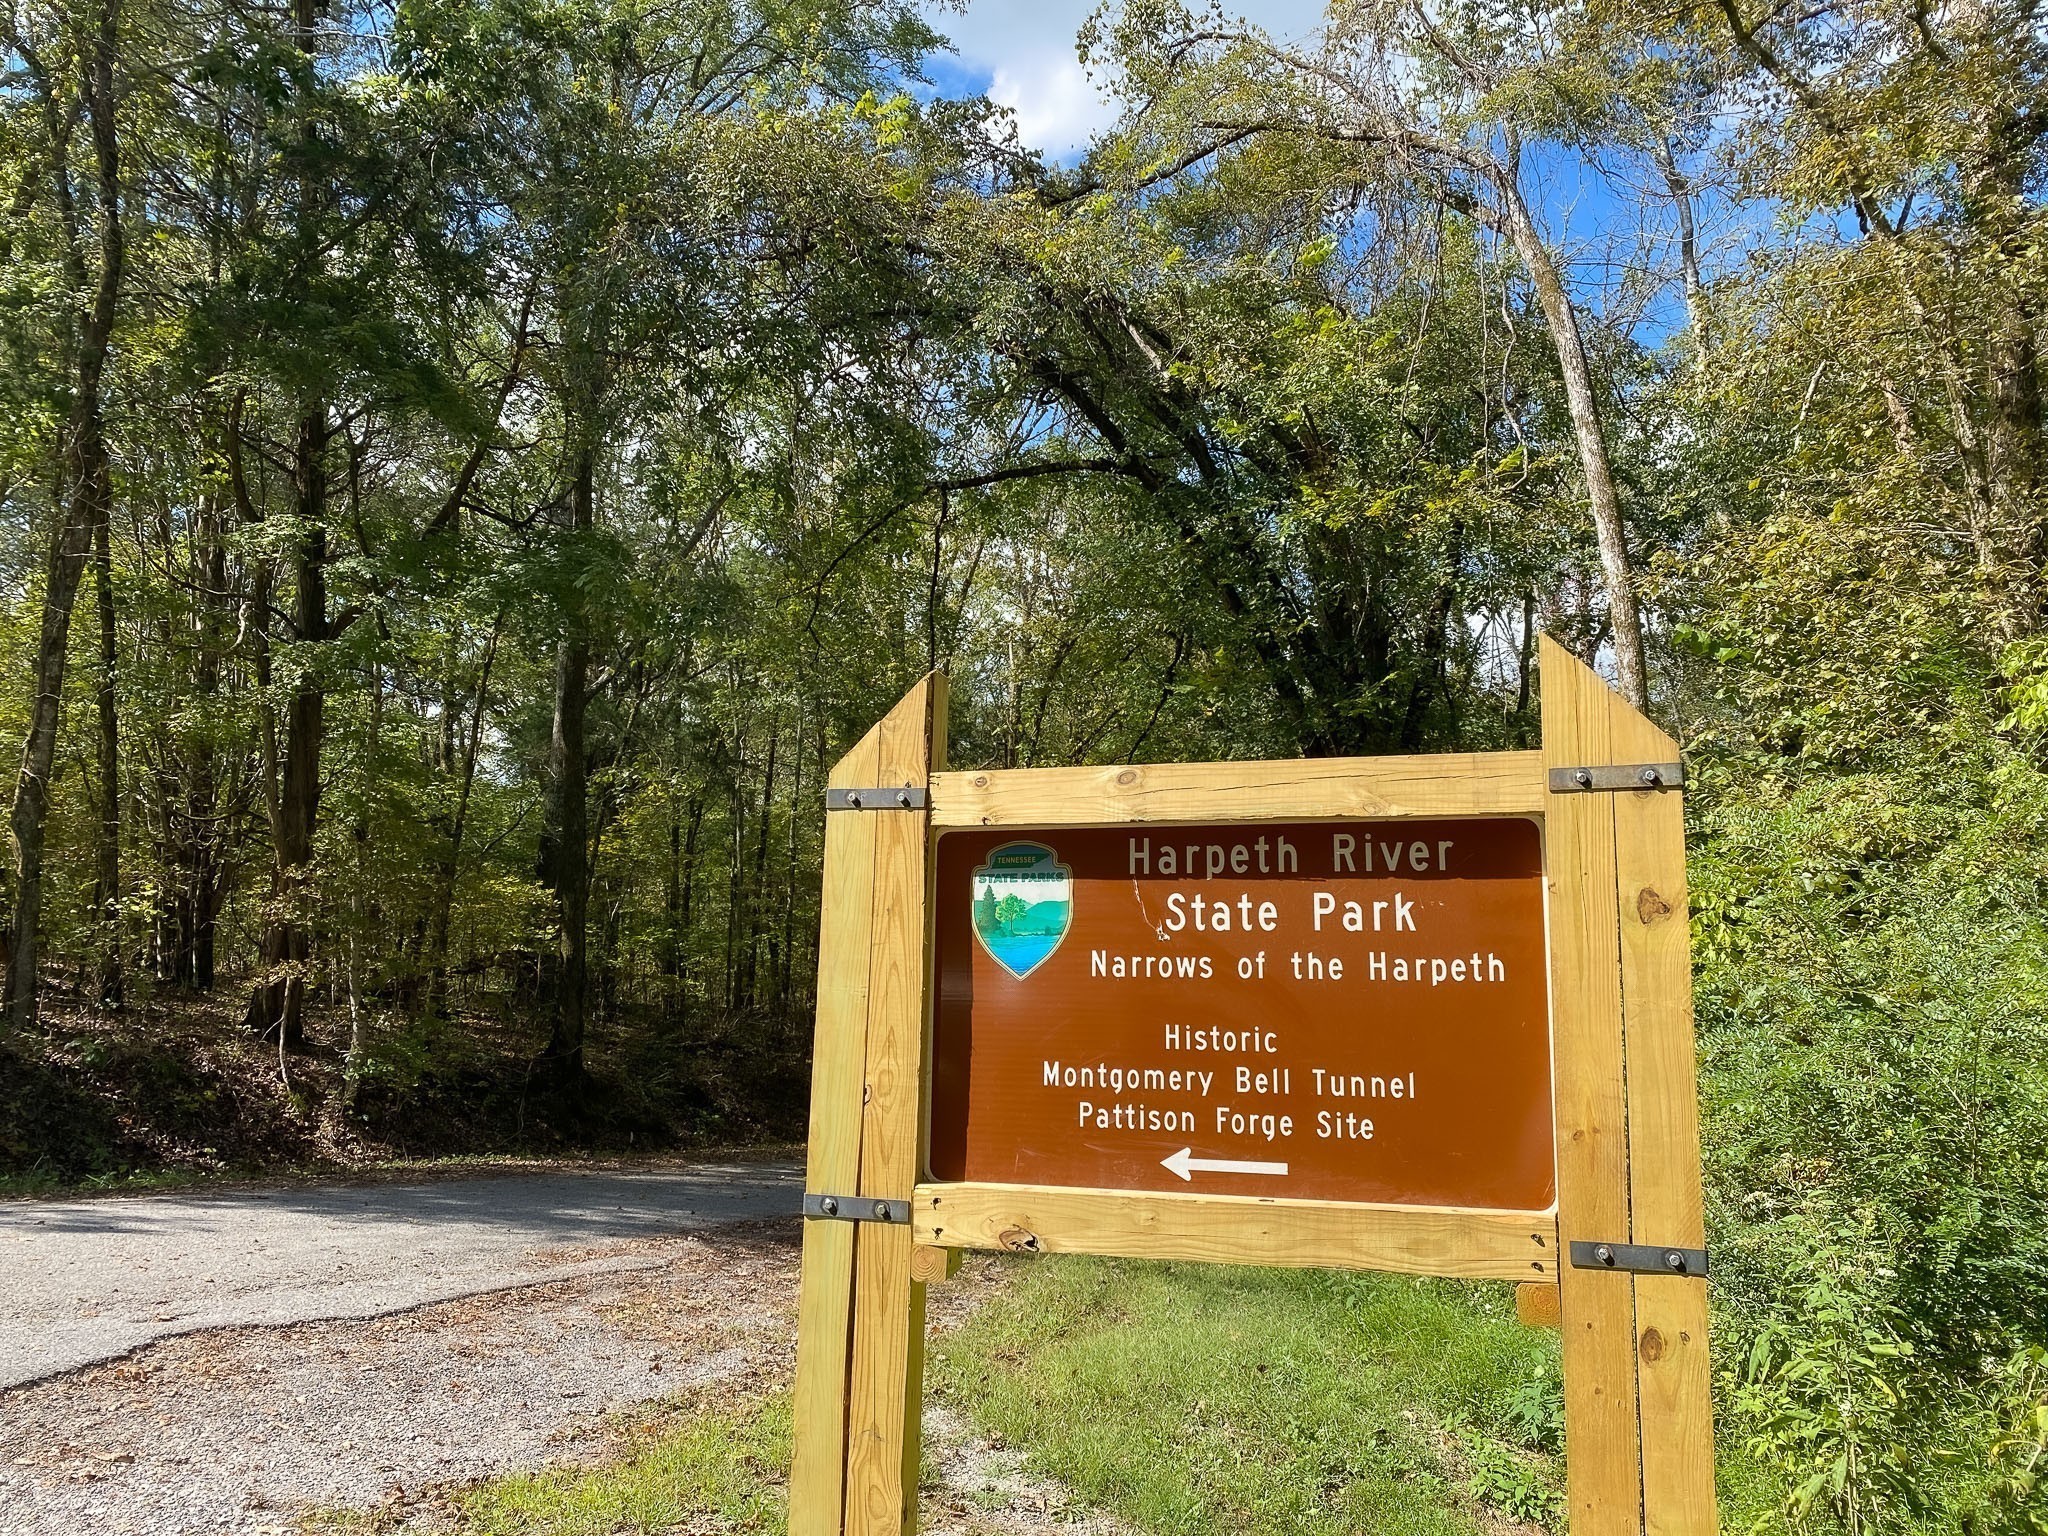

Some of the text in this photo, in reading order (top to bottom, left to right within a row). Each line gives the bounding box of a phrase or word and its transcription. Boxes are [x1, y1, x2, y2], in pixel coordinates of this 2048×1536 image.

[1129, 834, 1454, 881] Harpeth River
[978, 872, 1064, 884] STATE PARKS
[1165, 892, 1417, 932] State Park
[1090, 950, 1505, 986] Narrows of the Harpeth
[1165, 1024, 1277, 1054] Historic
[1043, 1060, 1416, 1099] Montgomery Bell Tunnel
[1079, 1103, 1374, 1142] Pattison Forge Site
